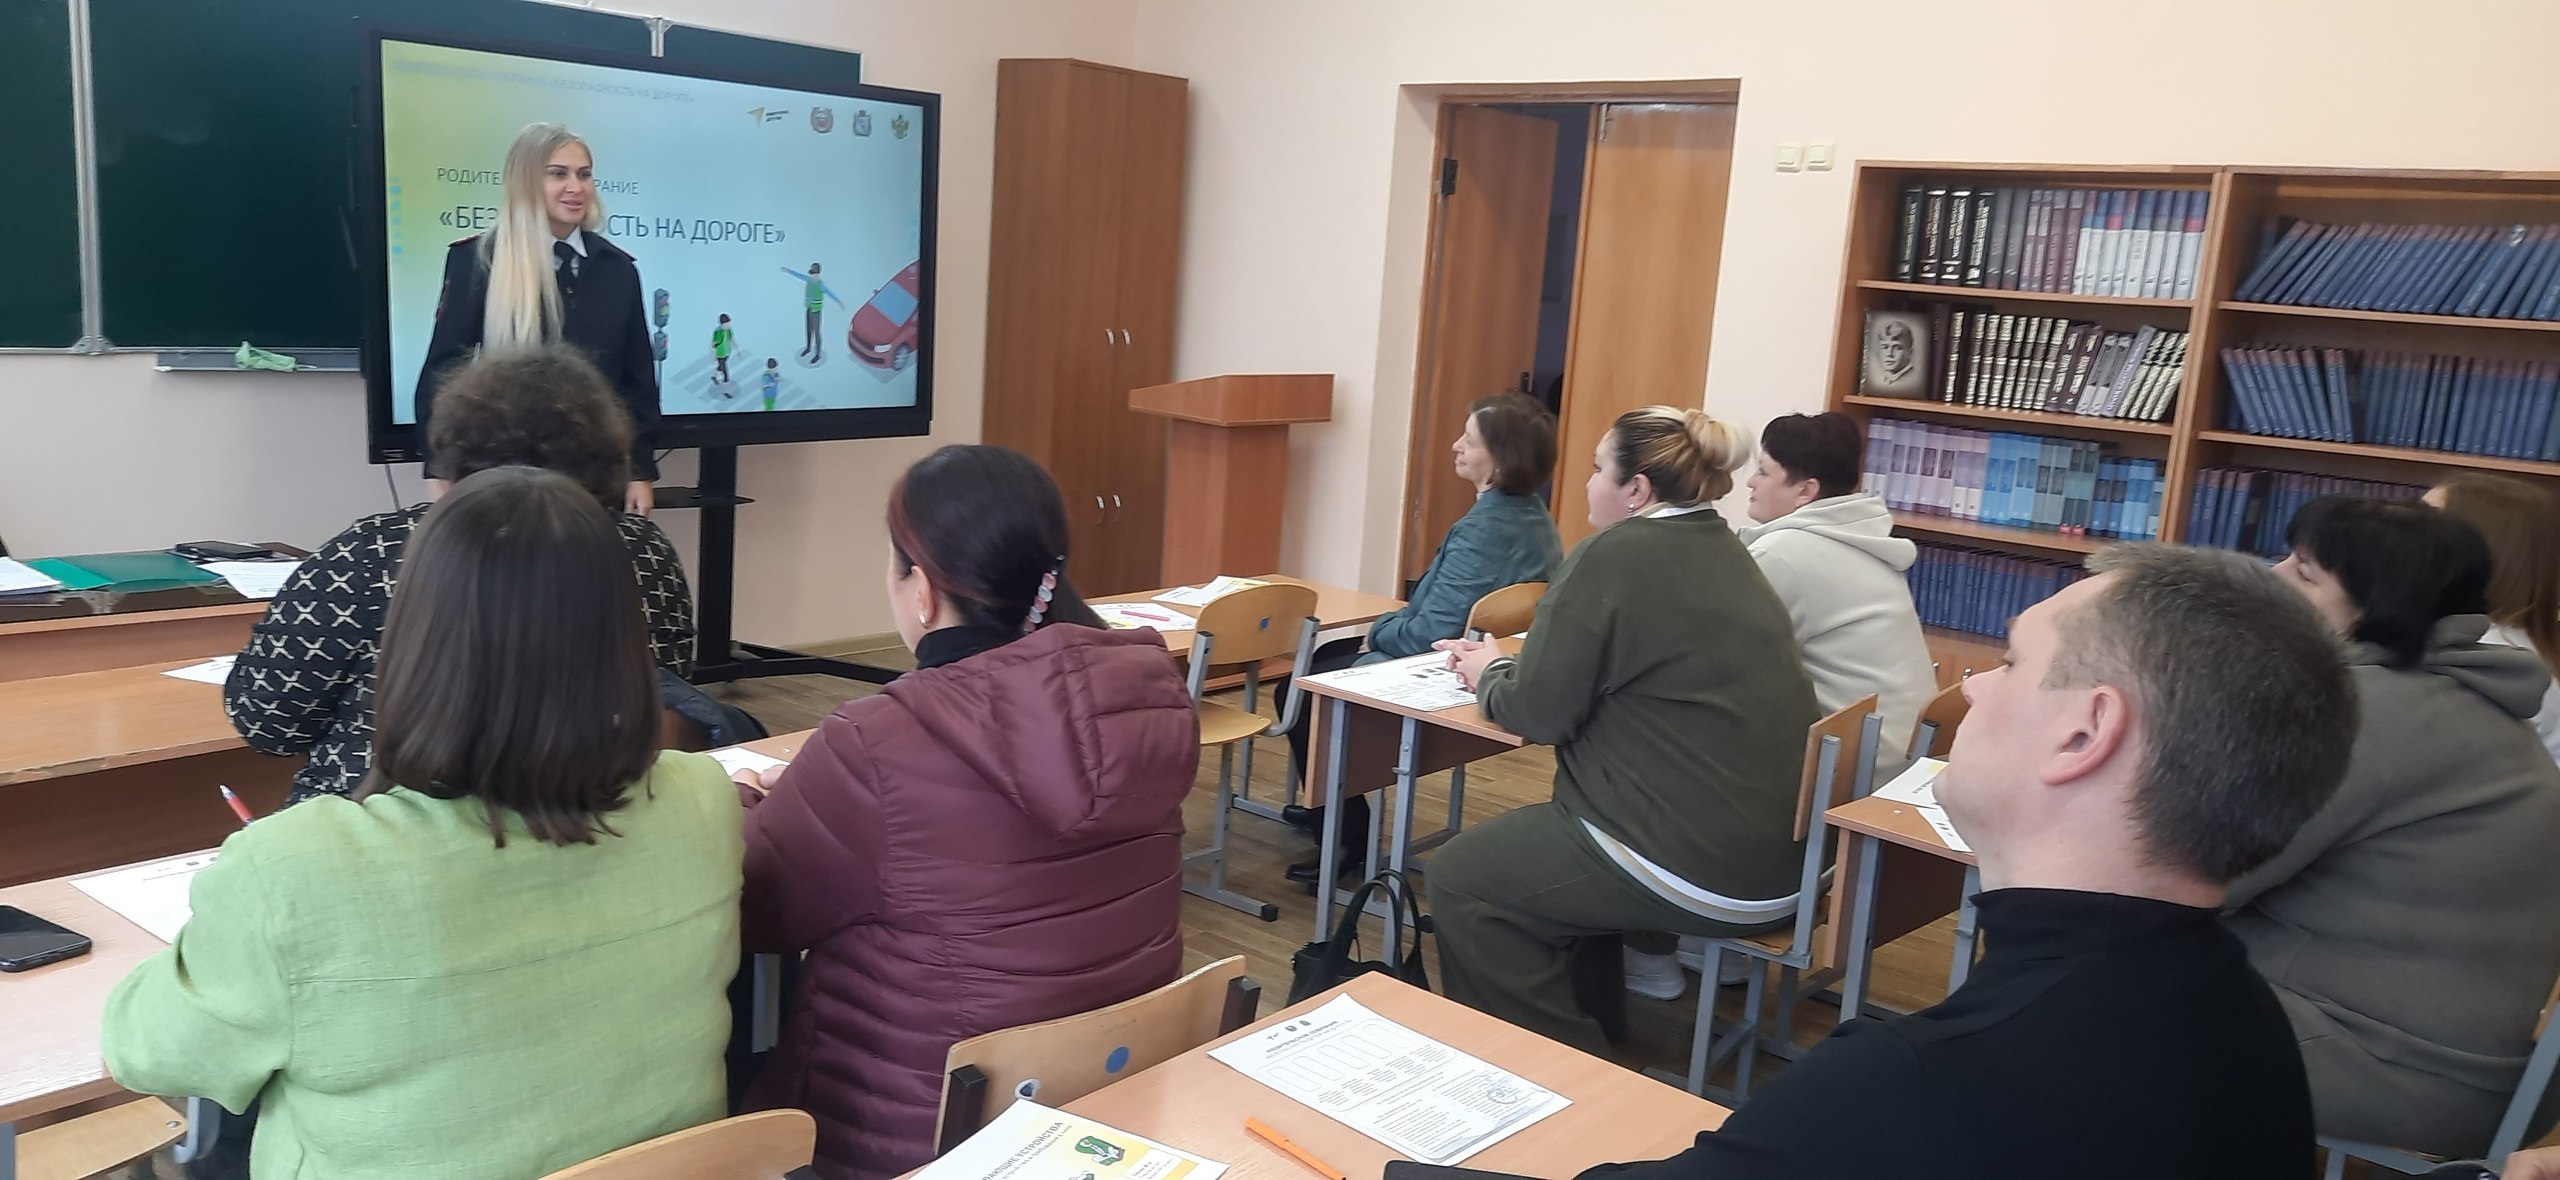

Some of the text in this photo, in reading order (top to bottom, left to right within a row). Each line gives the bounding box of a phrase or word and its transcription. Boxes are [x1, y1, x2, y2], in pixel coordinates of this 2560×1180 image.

[437, 167, 639, 195] РОДИТЕ РАНИЕ
[654, 217, 686, 239] НА
[690, 219, 786, 245] ДОРОГЕ»
